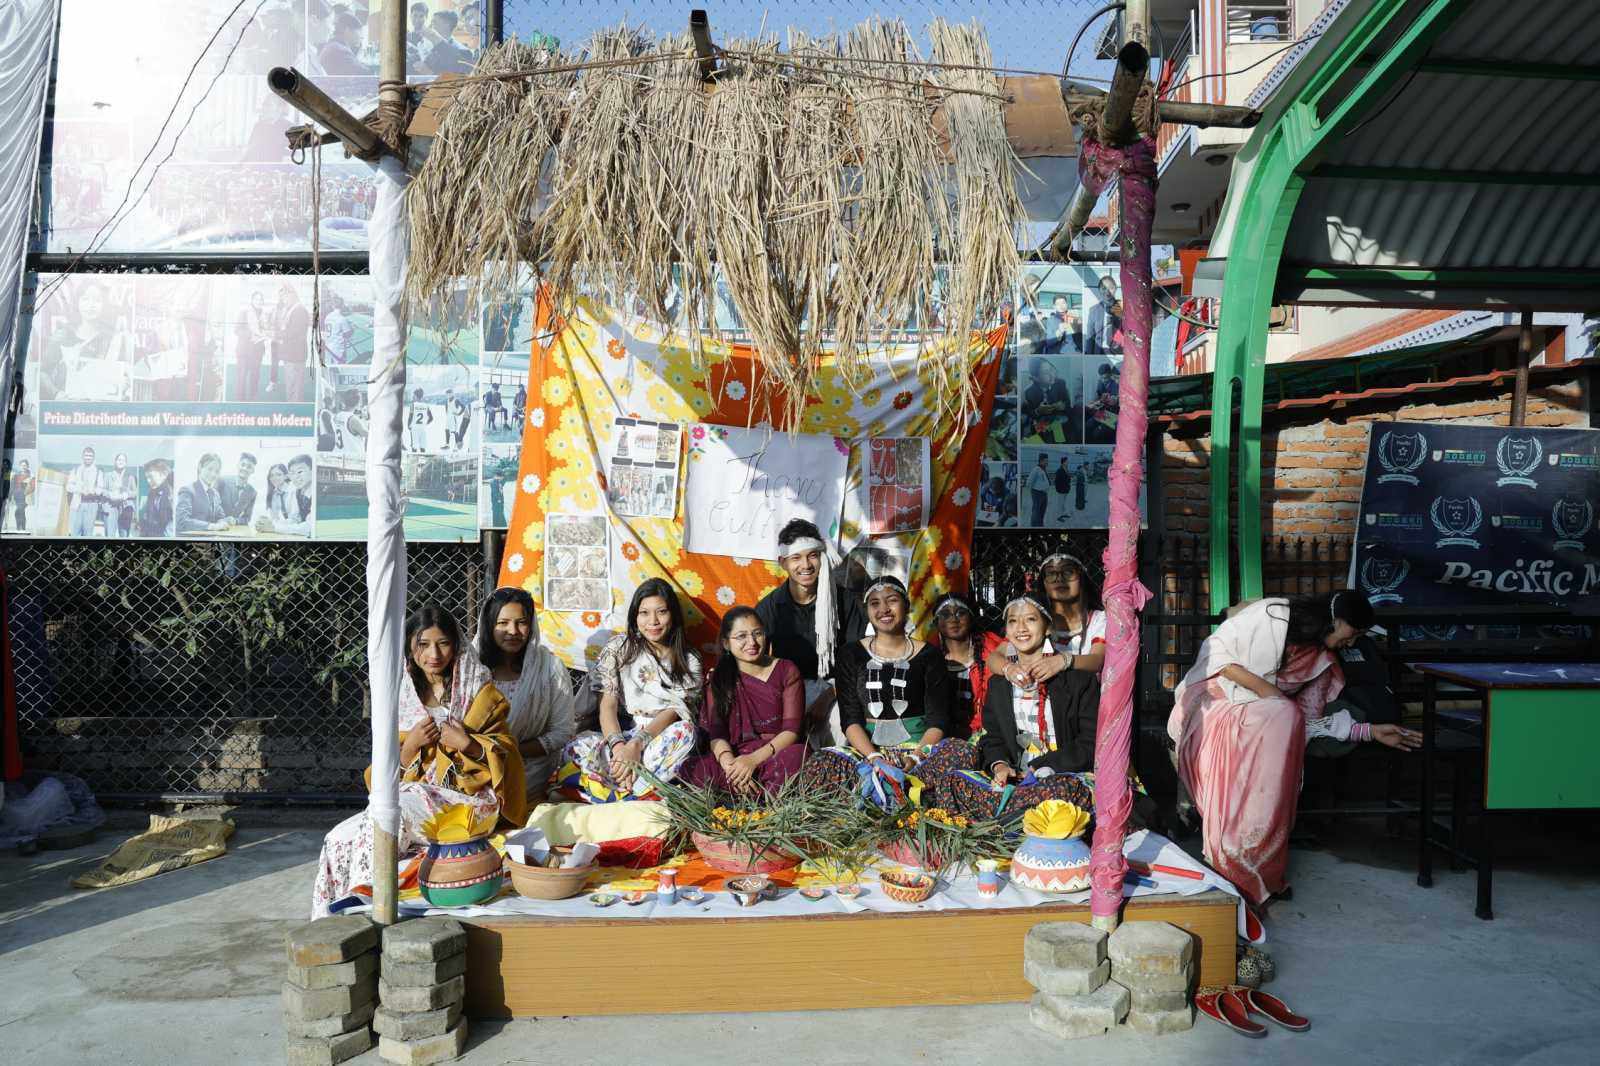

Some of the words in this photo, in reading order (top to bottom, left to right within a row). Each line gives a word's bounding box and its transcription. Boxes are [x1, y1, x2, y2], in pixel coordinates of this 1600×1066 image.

[43, 411, 71, 425] Prize
[73, 410, 139, 425] Distribution
[140, 412, 160, 425] and
[162, 411, 203, 425] Various
[204, 412, 256, 426] Activities
[257, 416, 271, 426] on
[272, 412, 313, 426] Modern
[415, 412, 424, 425] 2
[335, 429, 345, 450] 3
[1434, 558, 1574, 596] Pacific
